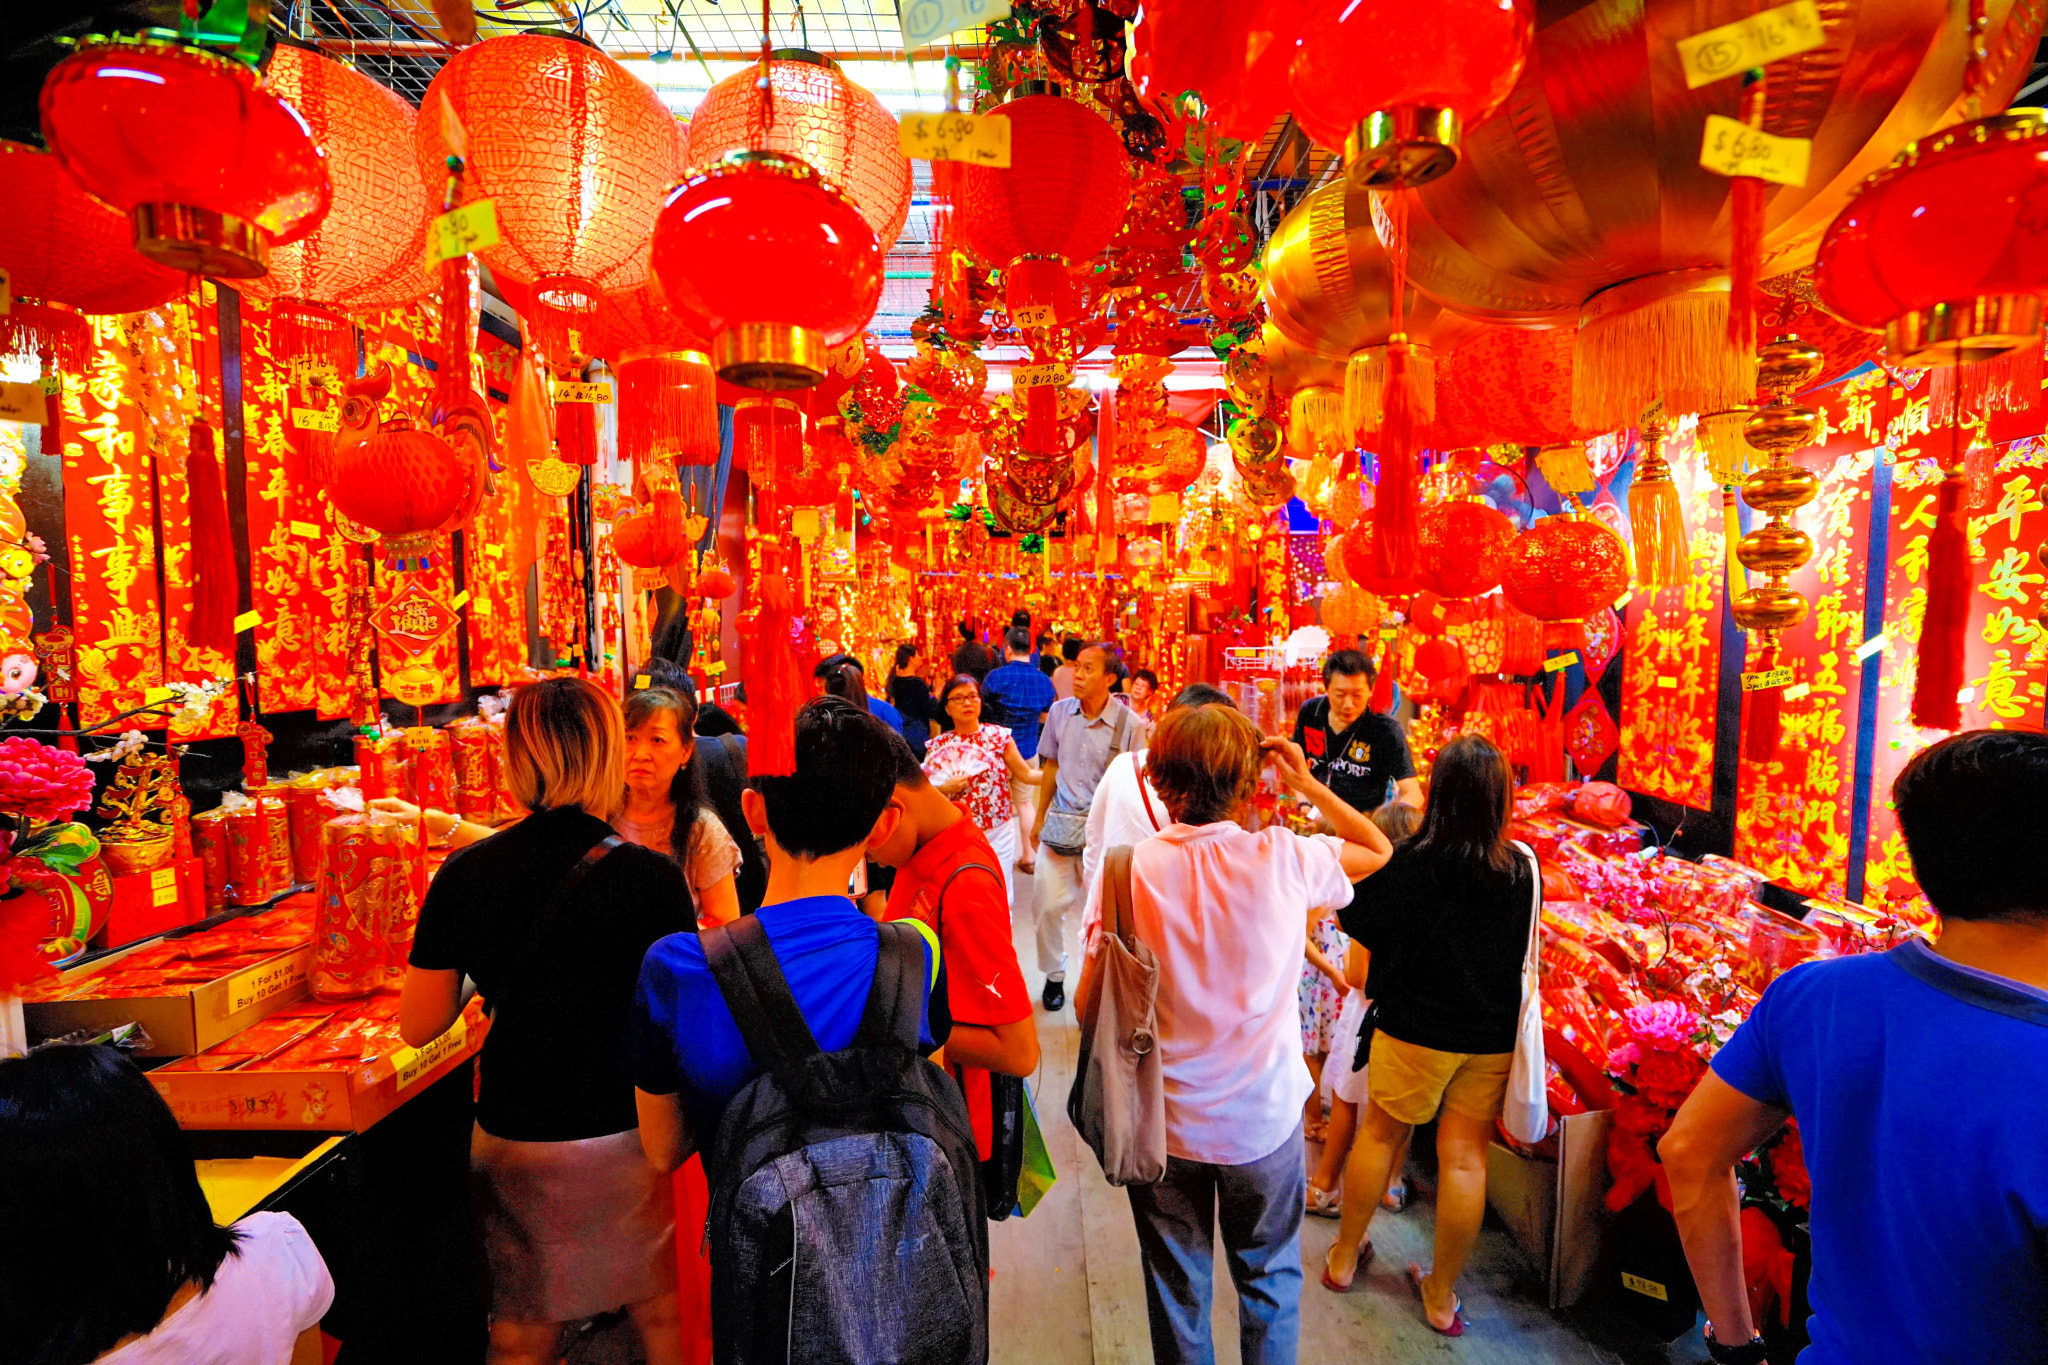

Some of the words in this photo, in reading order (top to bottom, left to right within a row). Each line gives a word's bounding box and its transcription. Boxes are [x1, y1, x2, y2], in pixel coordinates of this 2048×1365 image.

[1017, 311, 1032, 324] TJ
[258, 973, 272, 986] For
[274, 964, 295, 980] $1.00
[237, 995, 254, 1010] Buy
[256, 988, 266, 999] 10
[268, 982, 283, 995] Get
[403, 1068, 419, 1082] Buy
[419, 1060, 429, 1073] 10
[429, 1051, 442, 1065] Get
[448, 1038, 463, 1054] Free
[420, 1044, 434, 1056] For
